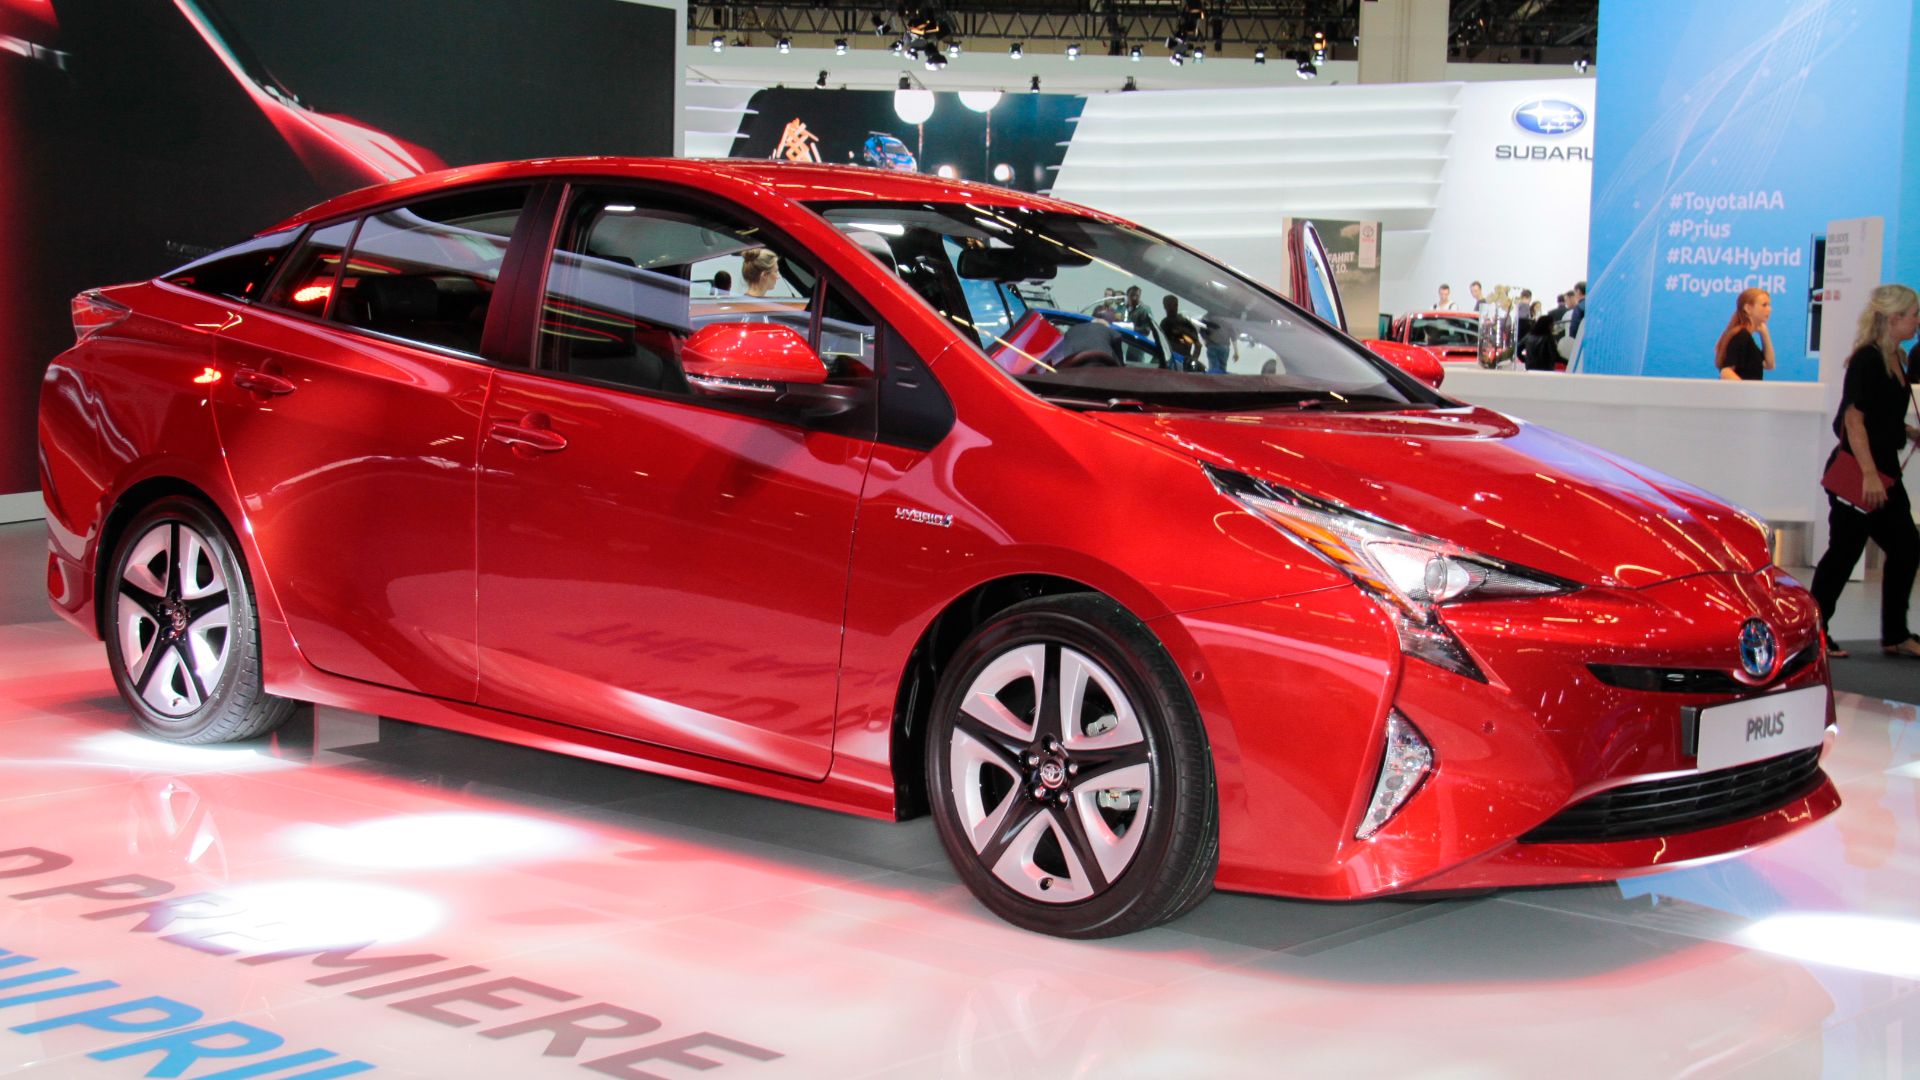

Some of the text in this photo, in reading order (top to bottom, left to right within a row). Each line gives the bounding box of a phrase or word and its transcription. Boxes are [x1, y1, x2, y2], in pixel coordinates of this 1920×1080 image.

[1669, 191, 1785, 215] #ToyotaIAA
[1668, 219, 1731, 238] #Prius
[1666, 246, 1801, 270] #RAV4Hybrid
[1665, 273, 1787, 297] #ToyotaCHR
[1746, 711, 1785, 742] PRIUS
